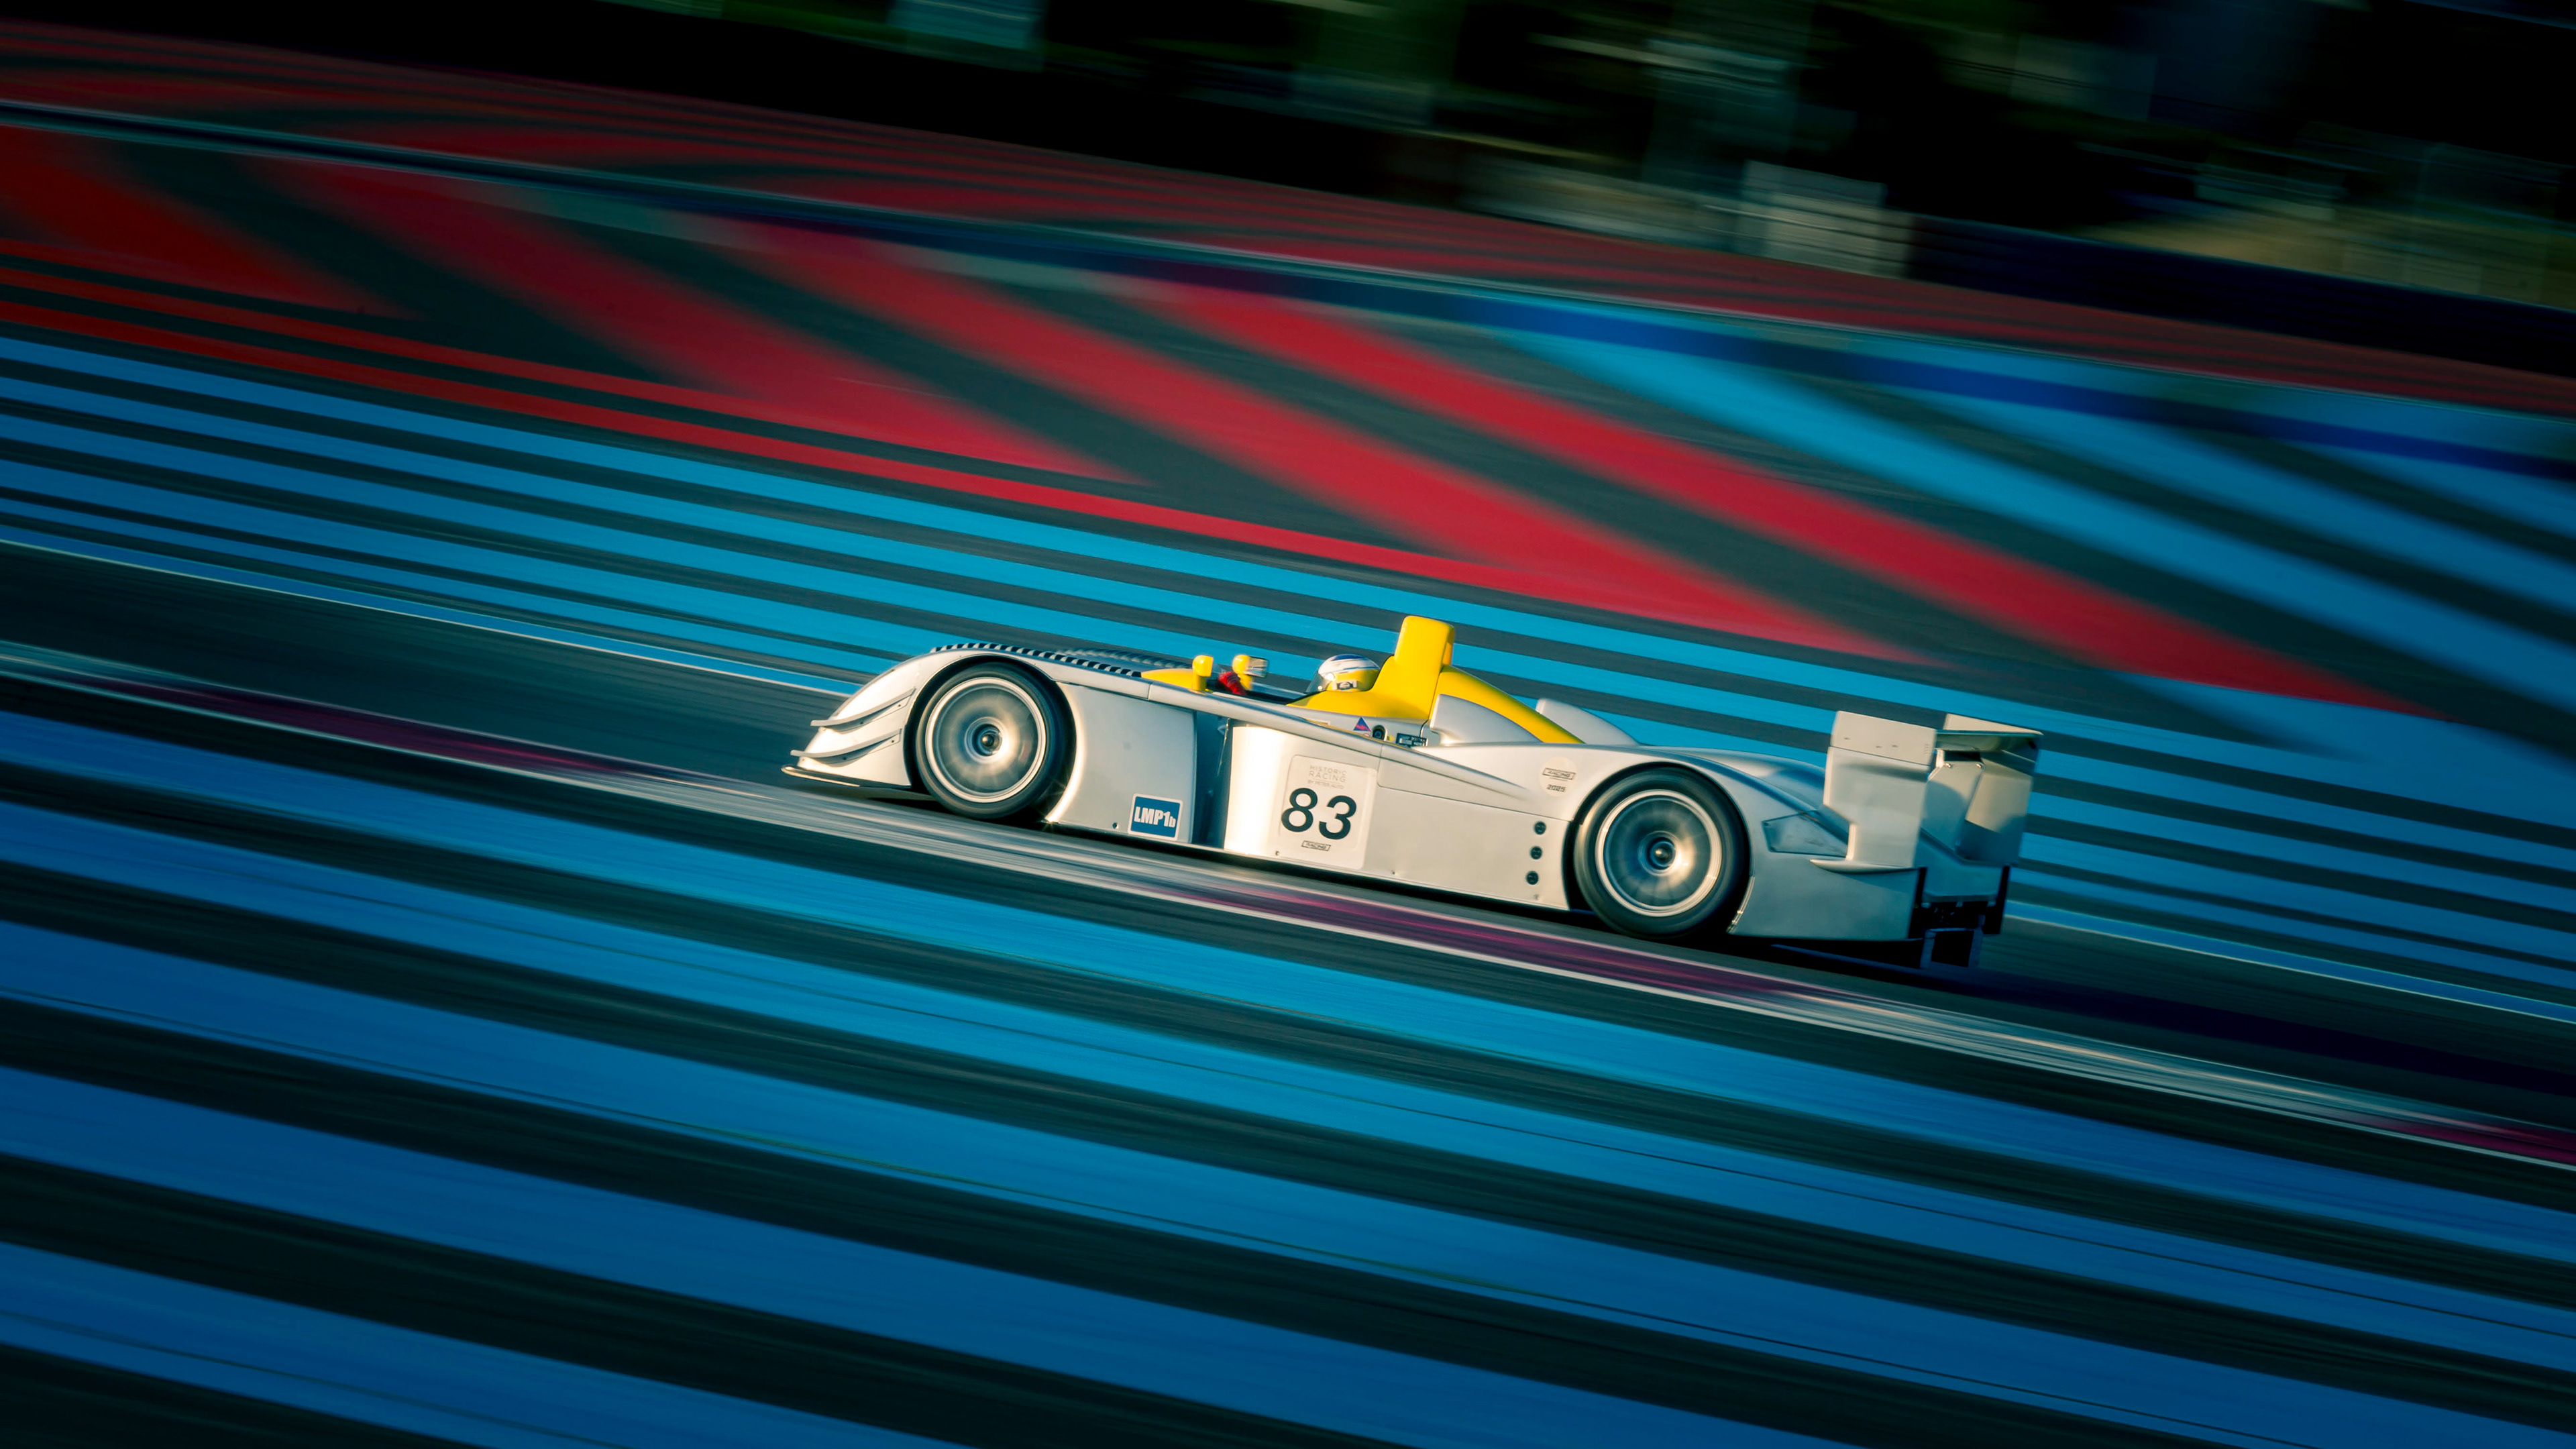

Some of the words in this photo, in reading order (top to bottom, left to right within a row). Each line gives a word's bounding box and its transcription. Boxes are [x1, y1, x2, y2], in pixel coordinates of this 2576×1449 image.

[1308, 770, 1346, 783] RACING
[1309, 765, 1347, 776] HISTORIC
[1134, 806, 1177, 828] LMP1b
[1281, 788, 1357, 840] 83
